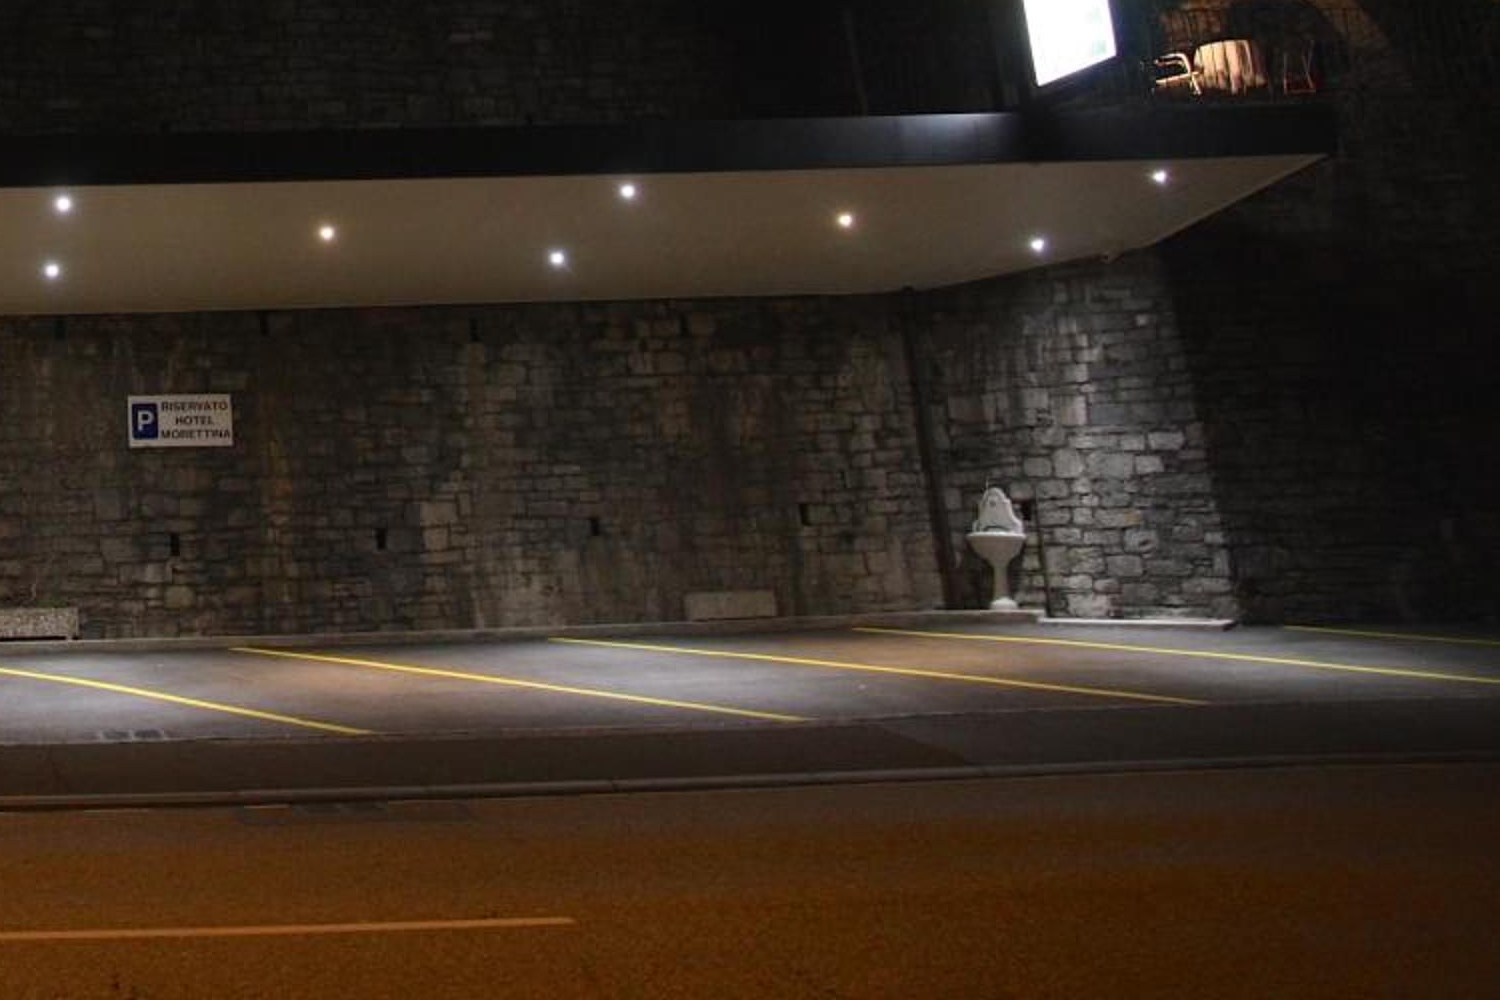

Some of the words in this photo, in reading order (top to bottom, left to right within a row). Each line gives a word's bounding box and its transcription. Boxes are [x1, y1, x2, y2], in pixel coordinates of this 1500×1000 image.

[161, 400, 228, 412] RISERVATO
[137, 410, 155, 431] P
[175, 415, 214, 425] HOTEL
[161, 428, 230, 439] MORETTINA
